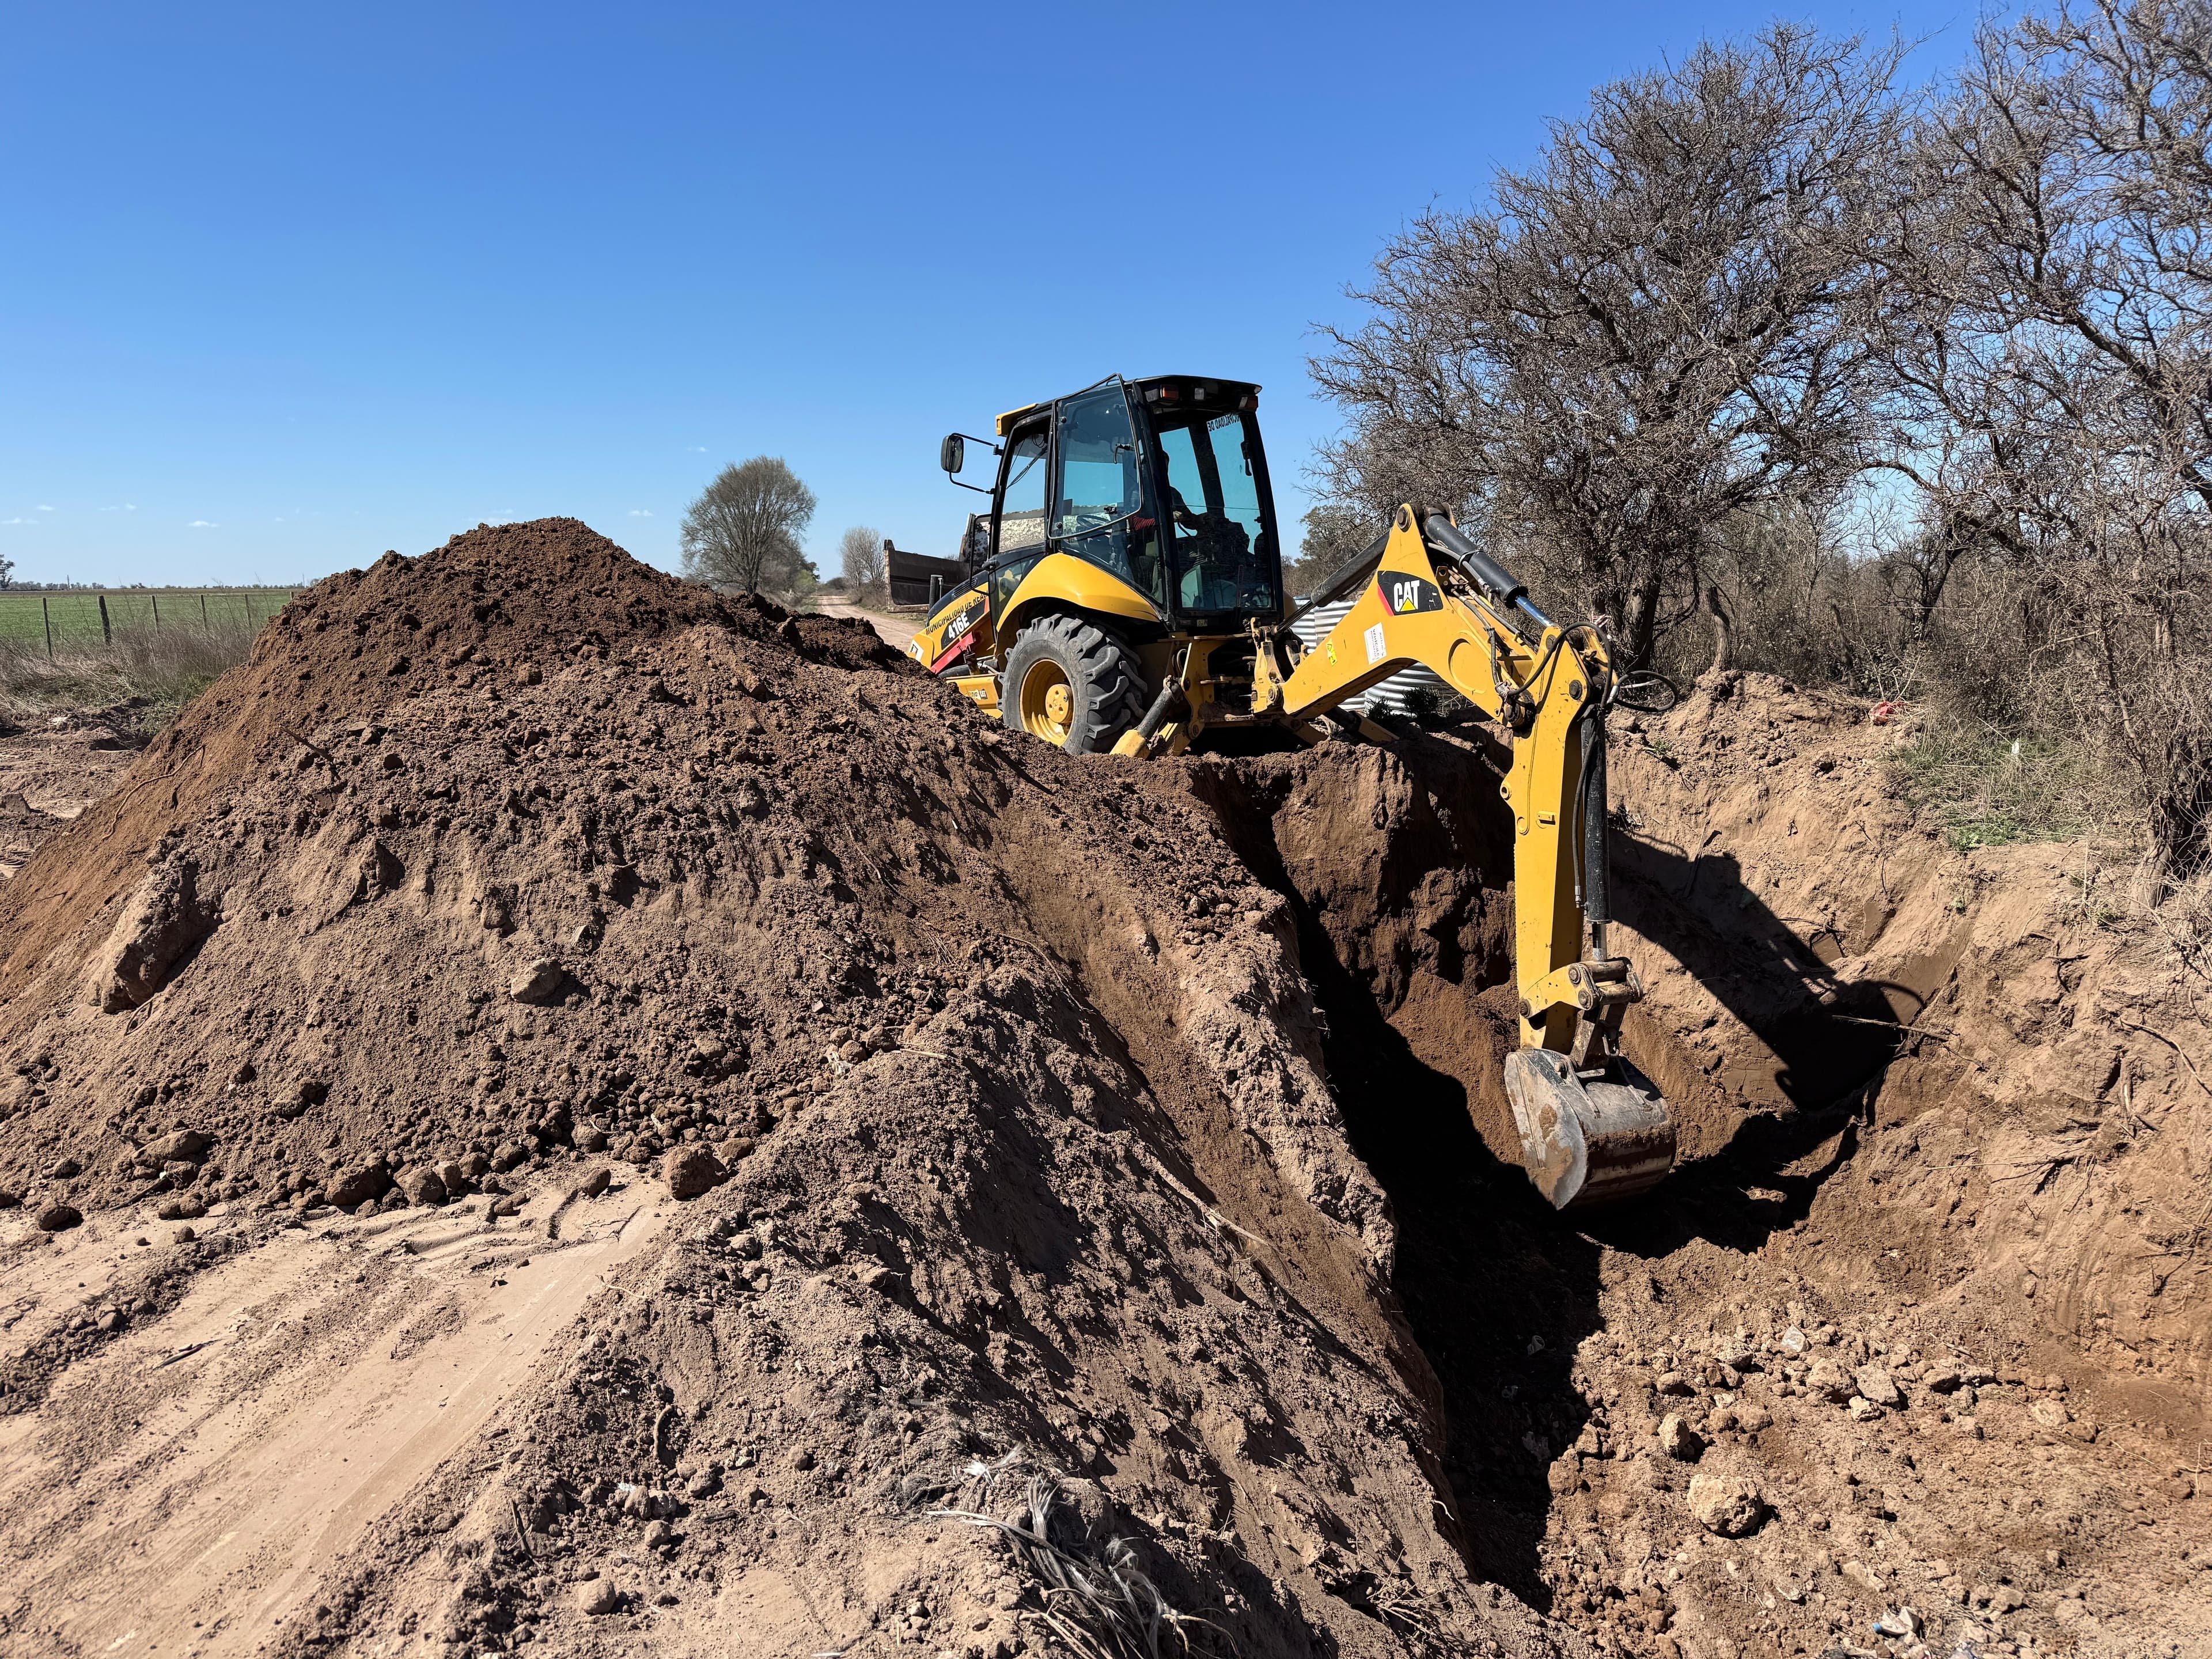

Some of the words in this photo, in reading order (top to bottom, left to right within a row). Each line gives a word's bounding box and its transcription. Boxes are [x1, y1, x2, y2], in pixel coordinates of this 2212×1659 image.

[1393, 579, 1420, 612] CAT
[925, 607, 964, 635] MUNICIPALIDAD
[965, 601, 972, 609] DE
[948, 612, 970, 639] 416E
